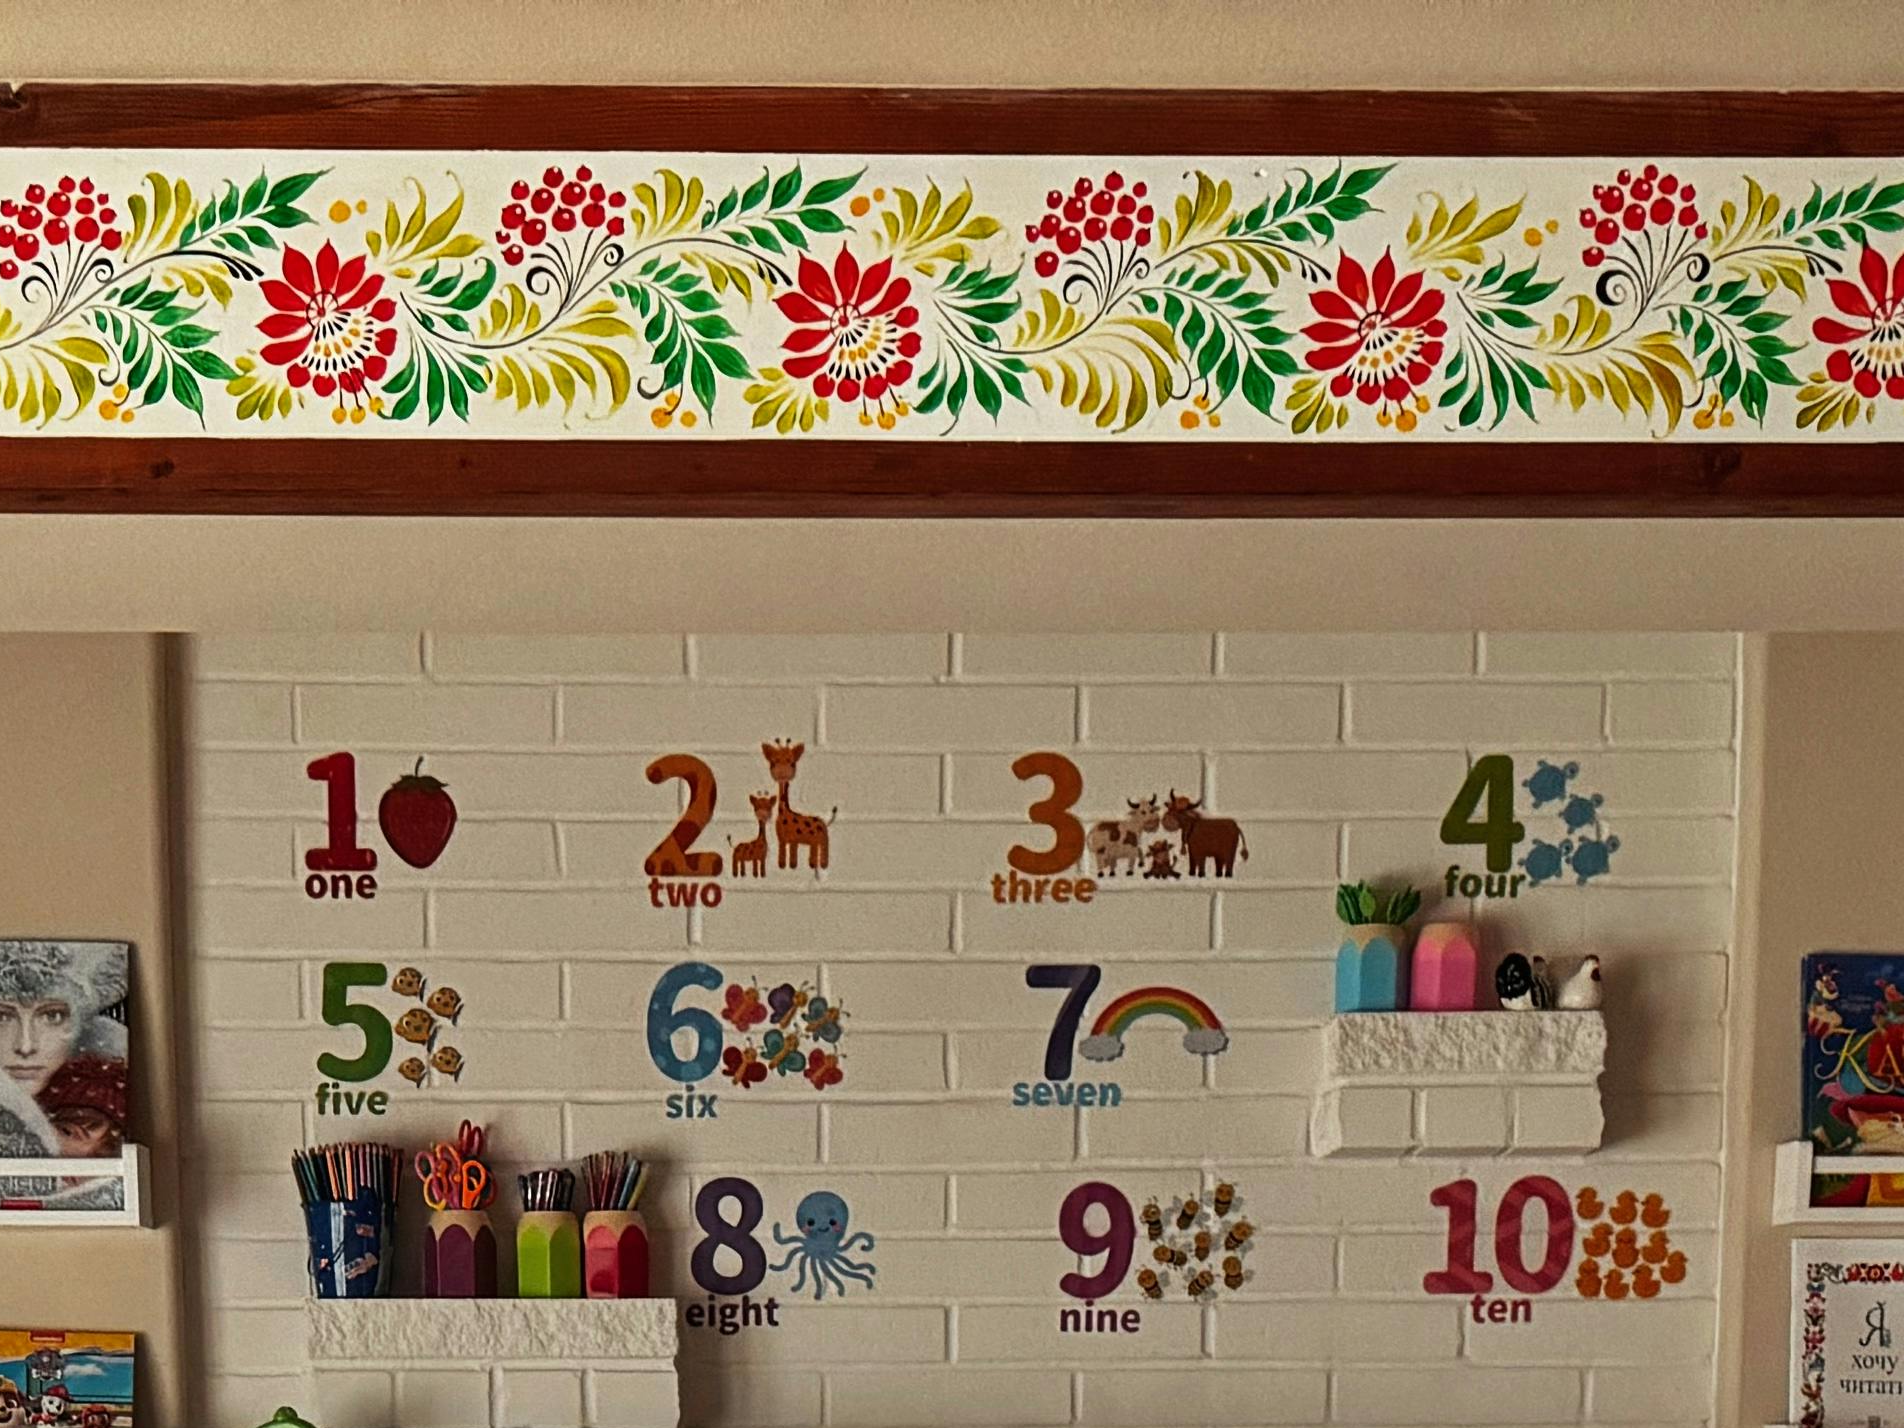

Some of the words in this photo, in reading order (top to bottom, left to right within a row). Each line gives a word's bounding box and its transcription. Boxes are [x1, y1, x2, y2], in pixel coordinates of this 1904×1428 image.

[305, 752, 378, 873] 1
[644, 754, 724, 876] 2
[1008, 753, 1086, 873] 3
[1440, 754, 1524, 875] 4
[305, 866, 378, 899] one
[649, 877, 724, 909] two
[991, 871, 1098, 905] three
[1444, 865, 1523, 903] four
[315, 962, 392, 1082] 5
[647, 962, 723, 1083] 6
[1025, 963, 1102, 1081] 7
[314, 1082, 390, 1117] five
[665, 1090, 718, 1119] six
[1012, 1078, 1124, 1109] seven
[689, 1177, 765, 1295] 8
[1059, 1183, 1136, 1299] 9
[1425, 1176, 1573, 1296] 10
[684, 1295, 781, 1337] eight
[1059, 1301, 1140, 1335] nine
[1469, 1294, 1533, 1324] ten
[1859, 1302, 1893, 1348] Я
[1851, 1353, 1899, 1375] хочу
